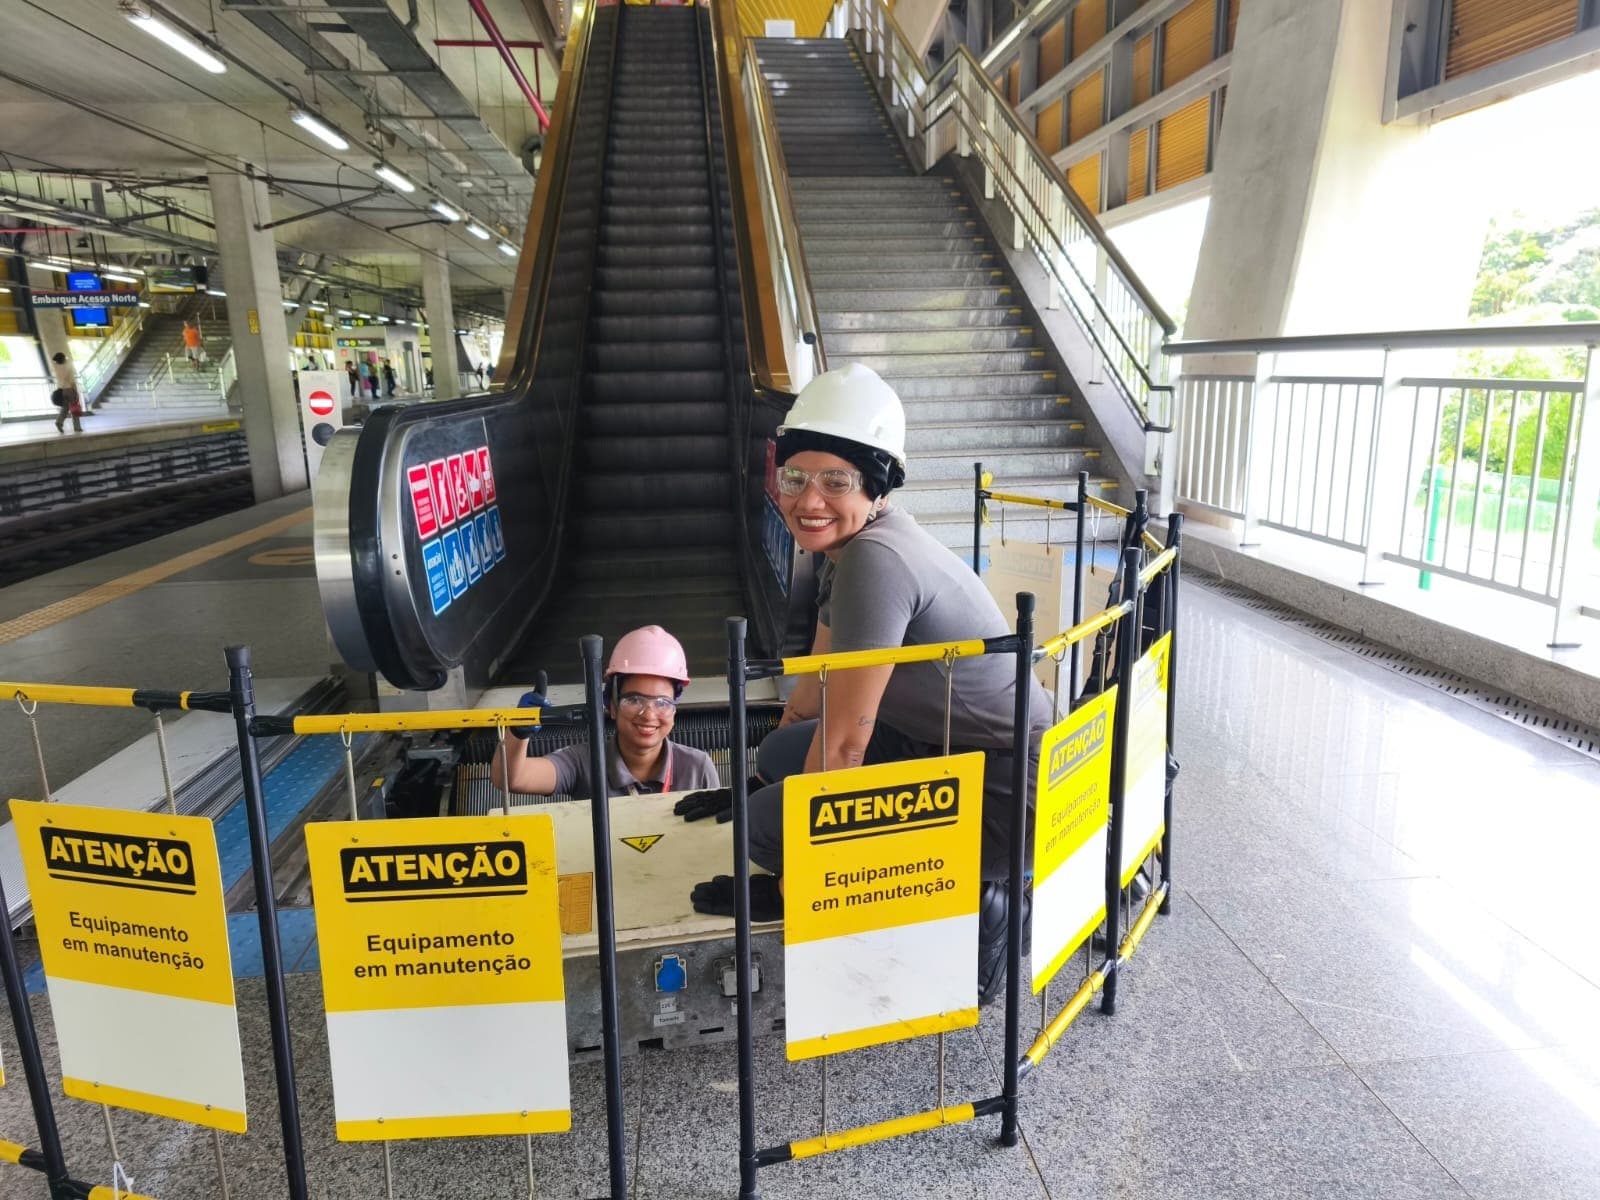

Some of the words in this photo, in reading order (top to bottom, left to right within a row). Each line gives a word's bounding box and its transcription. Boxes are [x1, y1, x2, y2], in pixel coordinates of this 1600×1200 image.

[32, 295, 76, 305] Embarque
[78, 294, 110, 303] Acesso
[112, 294, 136, 302] Norte
[1051, 717, 1105, 774] ATENÇÃO
[815, 784, 955, 828] ATENÇÃO
[1051, 782, 1098, 828] Equipamento
[1045, 834, 1058, 853] em
[1058, 798, 1101, 841] manutenção
[50, 835, 189, 878] ATENÇÃO
[349, 846, 520, 886] ATENÇÃO
[824, 857, 944, 888] Equipamento
[812, 898, 839, 912] em
[845, 877, 956, 908] manutenção
[70, 911, 189, 943] Equipamento
[367, 930, 515, 955] Equipamento
[62, 938, 88, 953] em
[94, 942, 204, 970] manutenção
[354, 963, 387, 978] em
[394, 954, 532, 976] manutenção
